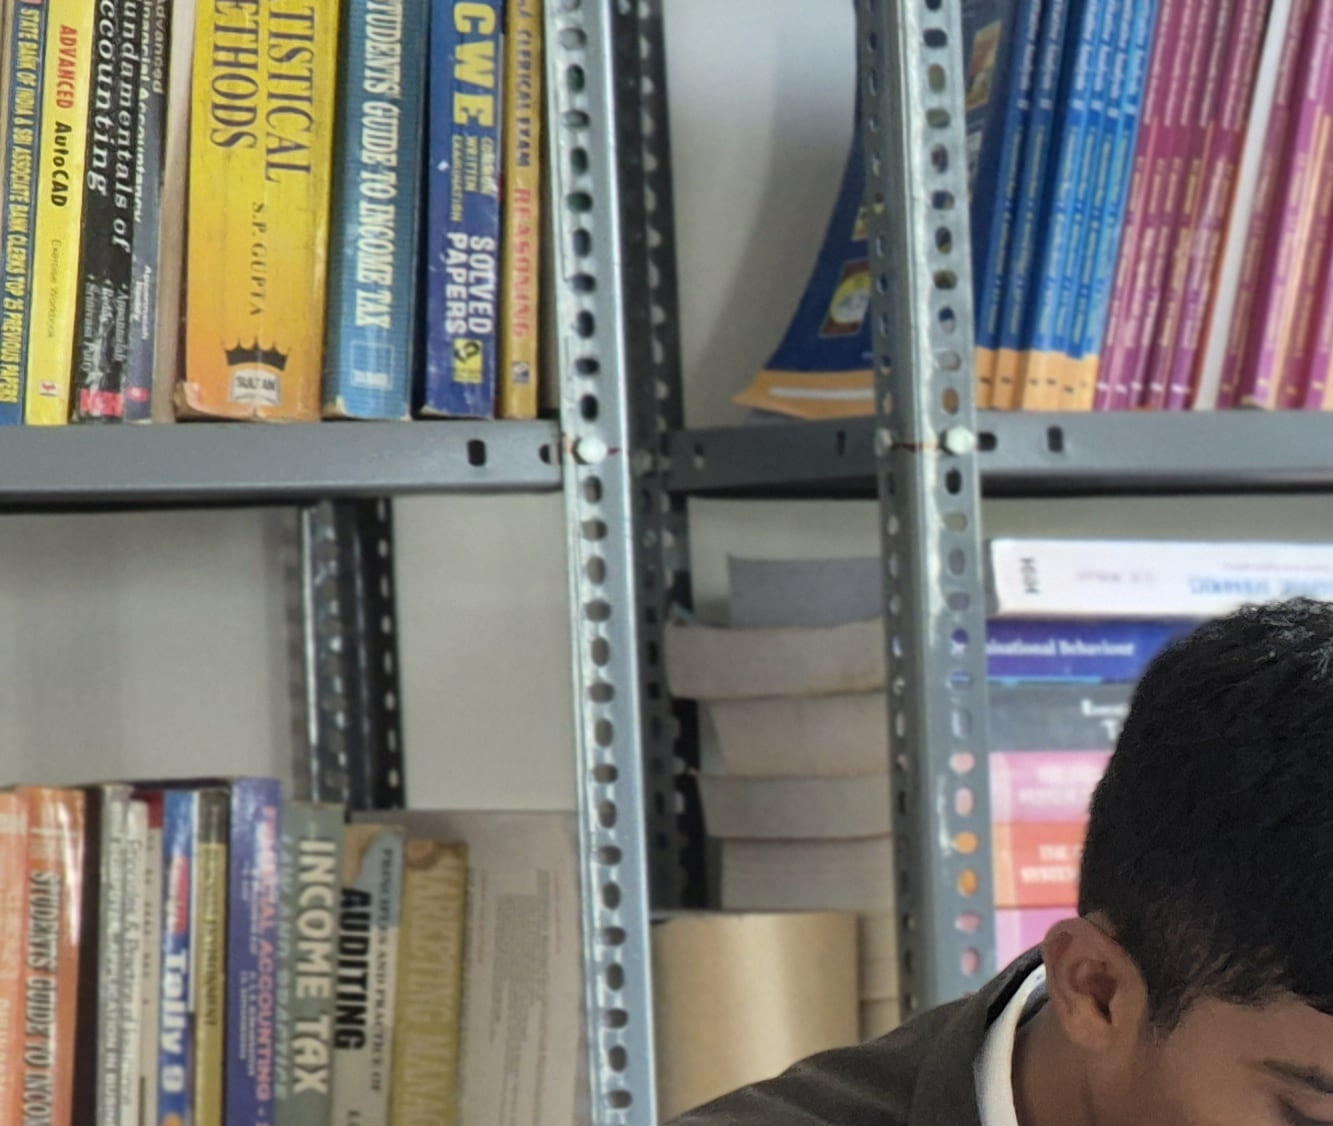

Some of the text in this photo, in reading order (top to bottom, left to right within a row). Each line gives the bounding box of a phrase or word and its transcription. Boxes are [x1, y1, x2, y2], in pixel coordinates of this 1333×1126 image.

[20, 8, 40, 39] STATE
[17, 71, 36, 87] OF
[18, 41, 38, 71] BANK
[452, 2, 497, 127] CWE
[15, 87, 35, 115] INDIA
[51, 25, 78, 207] ADVANCED AutoCAD
[264, 0, 315, 183] TISTICAL
[515, 29, 533, 168] CLERICAL EXAM
[13, 127, 34, 145] SBI
[360, 99, 401, 167] GUIDE
[10, 146, 33, 202] ASSOCIATE
[359, 169, 397, 201] TO
[451, 135, 464, 222] EXAMINATION
[465, 135, 480, 192] WRITTEN
[7, 204, 30, 233] BANK
[112, 218, 131, 253] of
[356, 200, 397, 286] INCOME
[6, 234, 29, 274] CLERKS
[250, 200, 267, 317] S.P. GUPTA
[445, 231, 469, 335] PAPERS
[512, 187, 533, 339] REASONING
[4, 275, 26, 297] TOP
[355, 288, 393, 329] TAX
[468, 236, 496, 334] SOLVED
[1, 311, 24, 362] PREVIOUS
[0, 364, 21, 404] PAPERS
[260, 805, 278, 933] FINANCIAL
[291, 839, 336, 1095] INCOME TAX
[333, 887, 373, 1051] AUDITING
[374, 949, 389, 987] AND
[26, 977, 58, 1036] GUIDE
[163, 949, 188, 1054] Tally
[256, 939, 275, 1100] ACCOUNTING
[371, 988, 387, 1069] PRACTICE
[24, 1039, 56, 1066] TO
